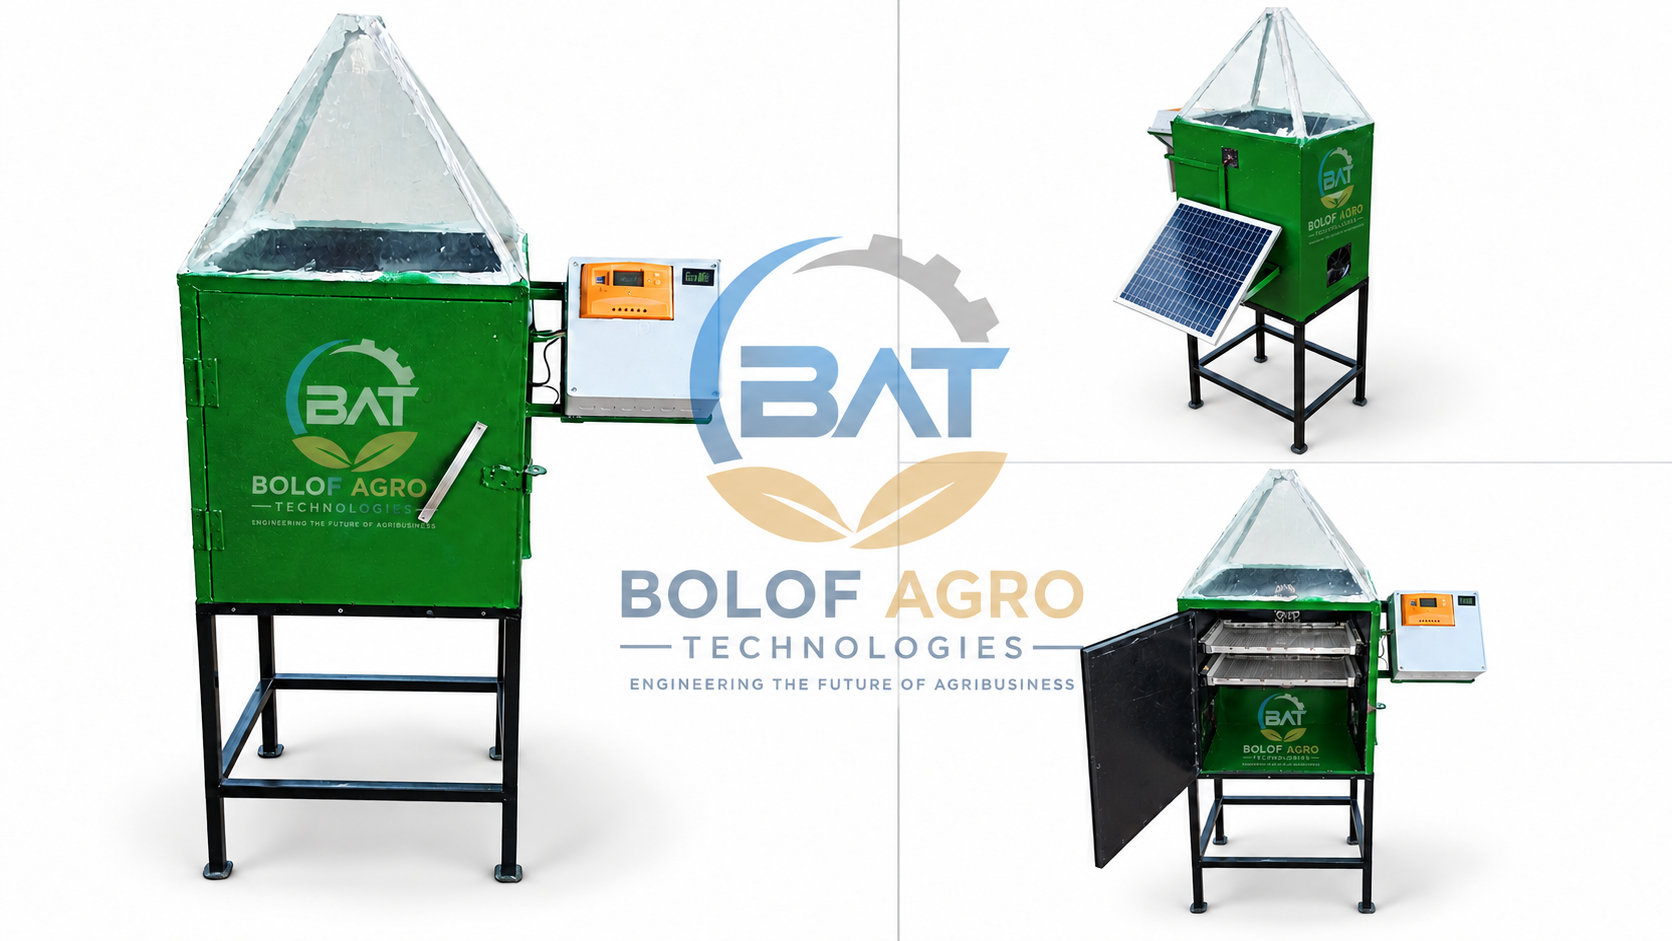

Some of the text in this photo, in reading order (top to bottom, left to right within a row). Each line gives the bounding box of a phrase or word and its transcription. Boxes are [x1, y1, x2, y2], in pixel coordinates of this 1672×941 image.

[1323, 164, 1354, 191] BAT
[1308, 212, 1337, 231] BOLOF
[306, 385, 420, 426] BAT
[252, 475, 427, 498] BOLOF AGRO
[275, 501, 412, 514] TECHNOLOGIES
[252, 519, 307, 527] ENGINEERING
[328, 520, 360, 528] FUTURE
[1265, 710, 1308, 726] BAT
[1243, 744, 1319, 754] BOLOF AGRO
